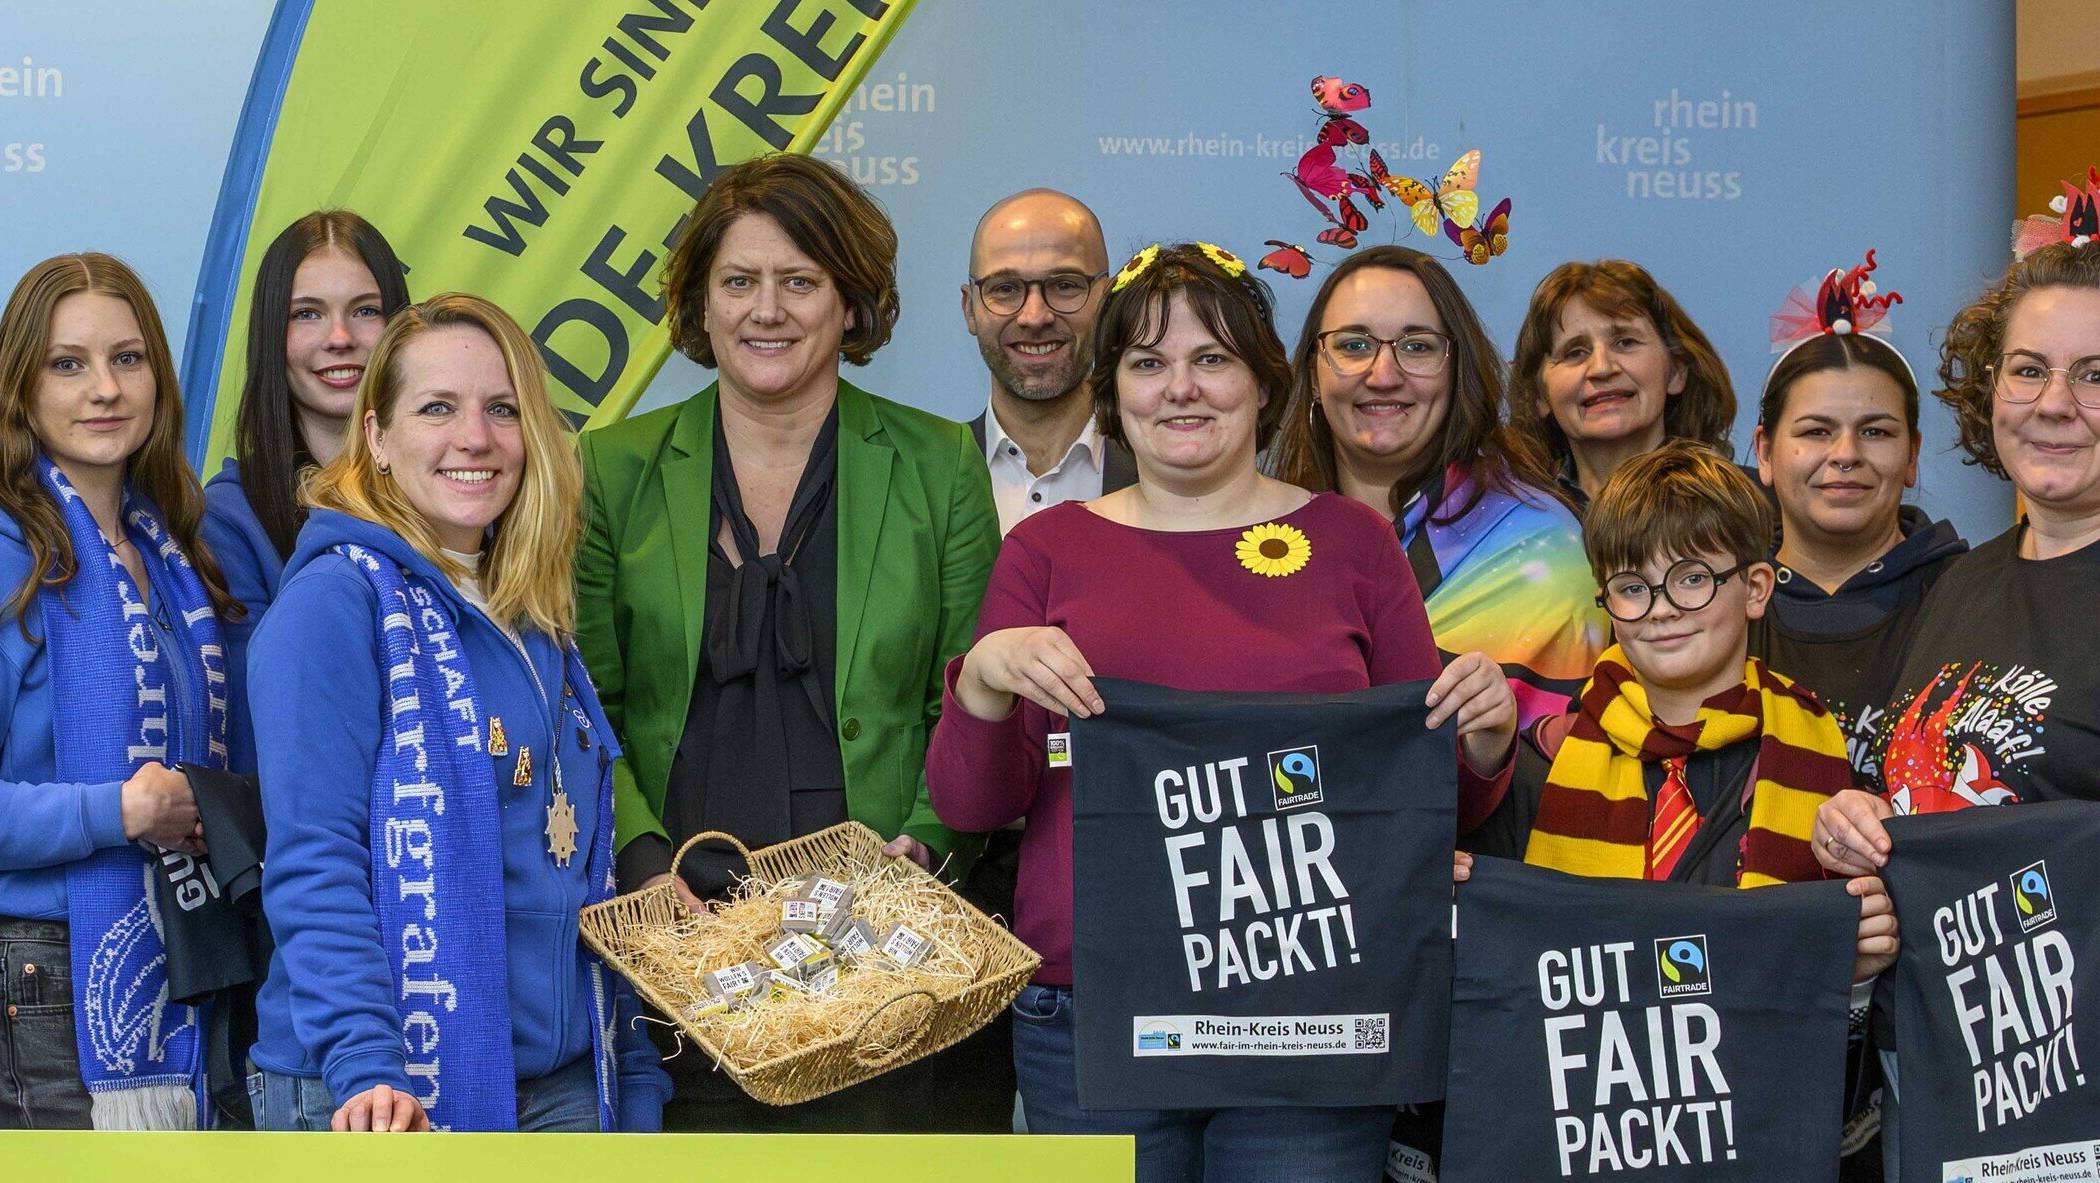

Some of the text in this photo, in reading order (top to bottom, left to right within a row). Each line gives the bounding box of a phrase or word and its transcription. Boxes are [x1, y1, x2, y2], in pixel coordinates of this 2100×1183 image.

[462, 0, 713, 257] WIR SIN
[1653, 88, 1757, 128] rhein
[1099, 131, 1440, 161] www.rhein-kreineuss.de
[1596, 124, 1692, 165] kreis
[529, 0, 890, 432] DE-KRE
[1626, 170, 1742, 199] neuss
[1988, 664, 2058, 715] Kölle
[1954, 696, 2046, 764] Alaaf!
[1154, 756, 1249, 830] GUT
[1278, 791, 1320, 806] FAIRTRADE
[158, 846, 207, 912] GU
[1164, 811, 1350, 929] FAIR
[1182, 903, 1361, 992] PACKT!
[1934, 882, 2004, 967] GUT
[2023, 908, 2054, 929] FAIRTRADE
[1538, 941, 1635, 1011] GUT
[1663, 982, 1707, 995] FAIRTRADE
[1946, 930, 2075, 1067] FAIR
[1192, 1040, 1347, 1051] www.fair-im-rhein-kreis-neuss.de
[1195, 1020, 1344, 1036] Rhein-Kreis Neuss
[1544, 1002, 1731, 1111] FAIR
[1973, 1022, 2087, 1133] PACKT!
[1555, 1099, 1737, 1176] PACKT!
[2043, 1151, 2086, 1168] Neuss
